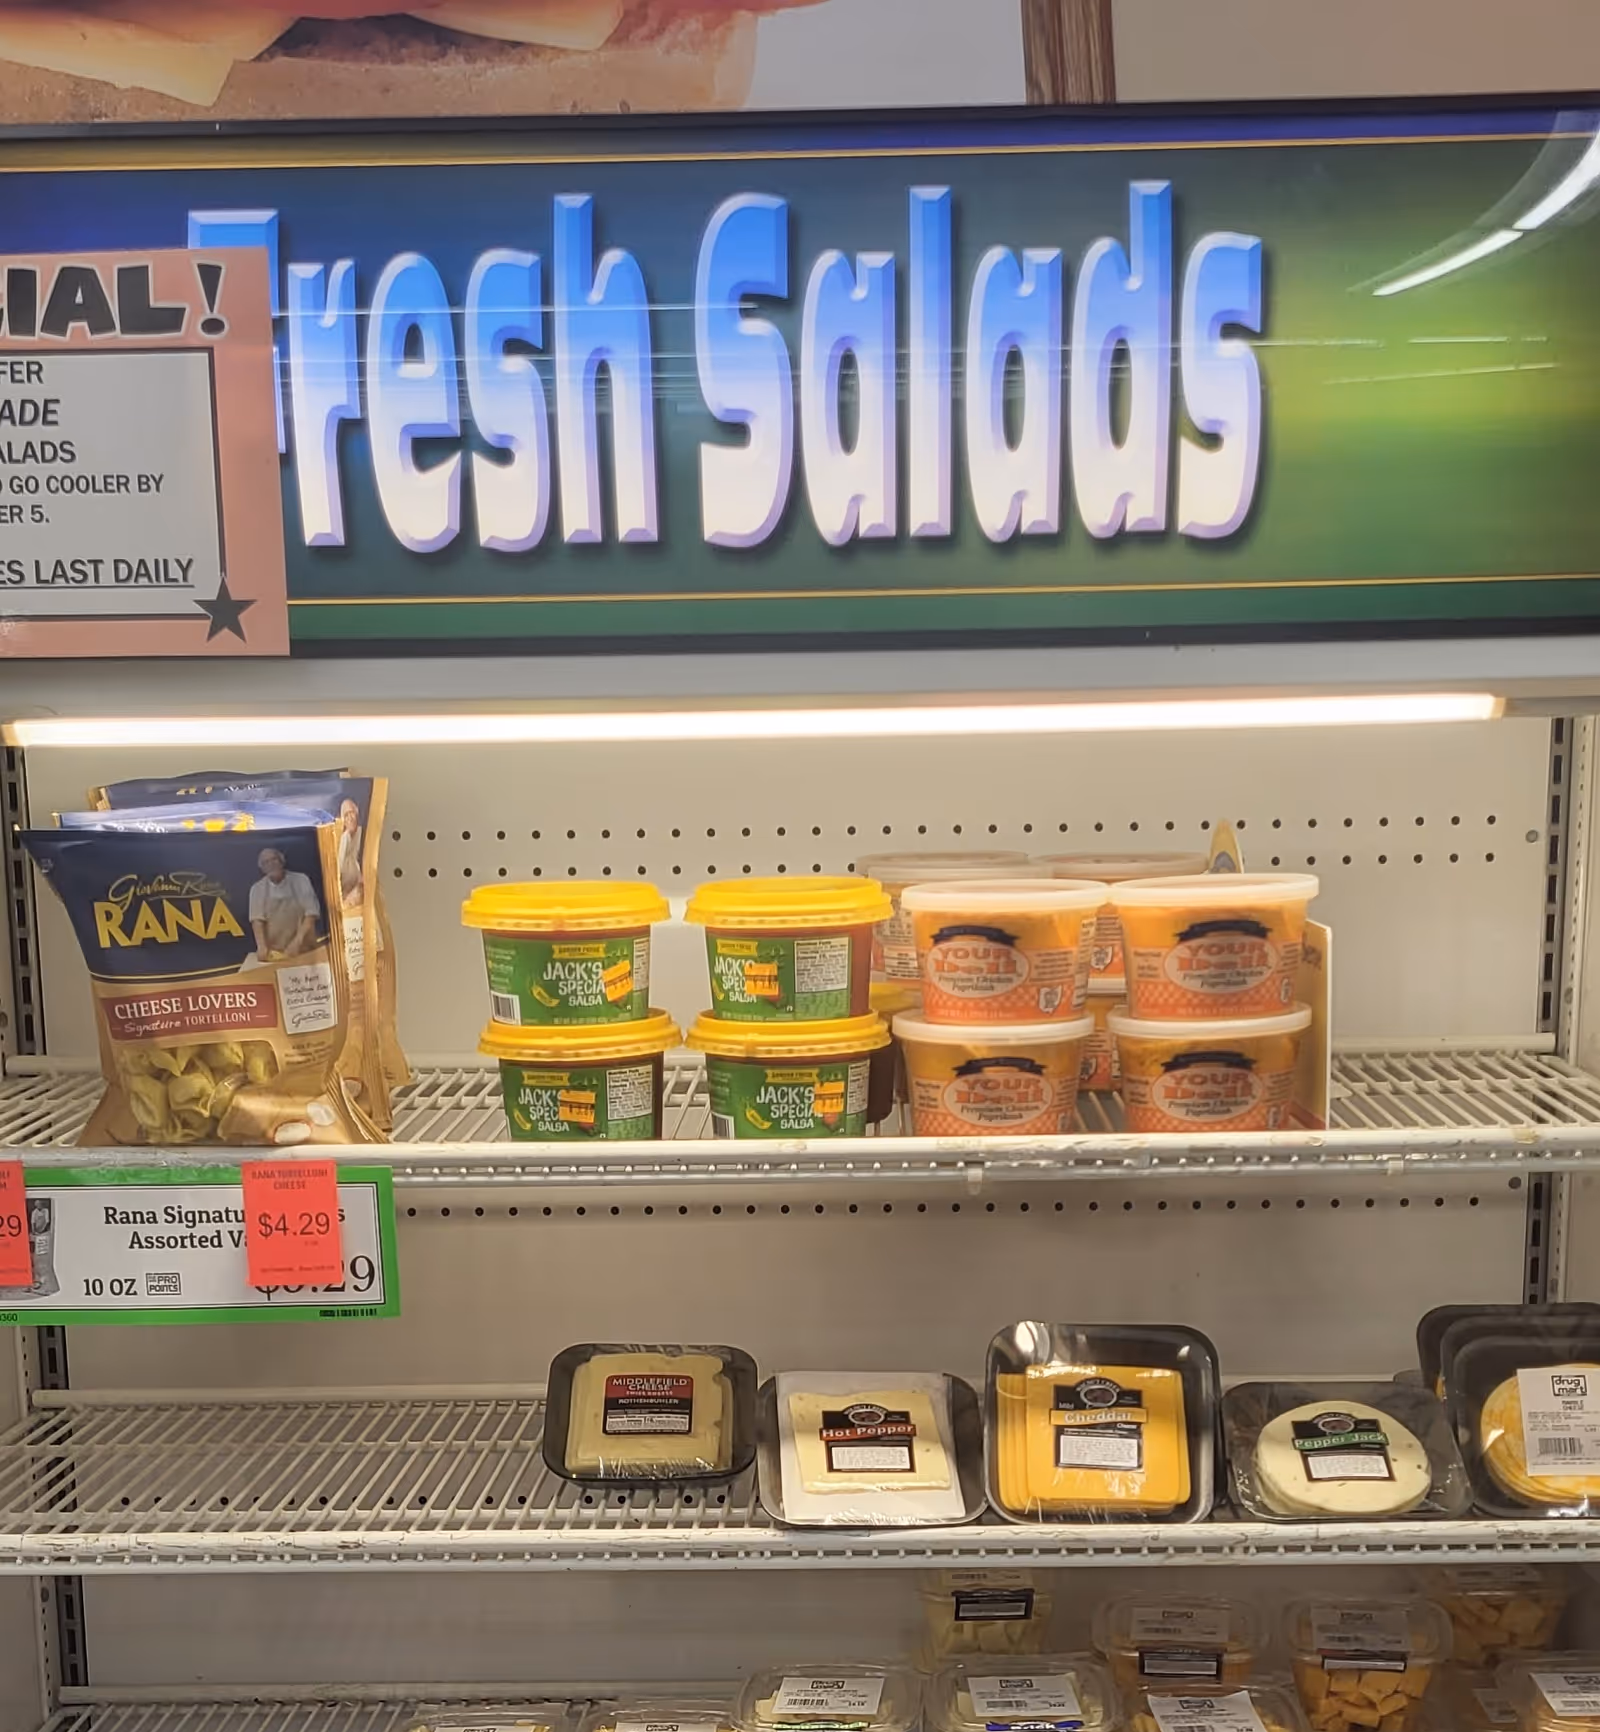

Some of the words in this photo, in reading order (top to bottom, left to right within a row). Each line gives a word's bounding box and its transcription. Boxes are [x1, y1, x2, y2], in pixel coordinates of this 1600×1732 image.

[0, 261, 229, 338] IAL!
[695, 180, 1263, 548] Salads
[9, 475, 39, 494] GO
[46, 474, 130, 494] COOLER
[137, 473, 164, 493] BY
[31, 504, 50, 523] 5.
[34, 558, 104, 585] LAST
[113, 557, 194, 584] DAILY
[94, 897, 245, 948] RANA
[543, 962, 603, 981] JACK'S
[559, 980, 606, 995] SPECIA
[722, 975, 746, 991] SPEC
[115, 997, 182, 1020] CHEESE
[186, 991, 258, 1012] LOVERS
[568, 995, 603, 1007] SALSA
[124, 1013, 181, 1036] Signature
[184, 1011, 251, 1027] TORTELLONI
[756, 1086, 815, 1104] JACK'S
[530, 1106, 559, 1121] SPEC
[538, 1121, 570, 1132] SALSA
[780, 1119, 814, 1129] SALSA
[104, 1207, 158, 1225] Rana
[164, 1204, 246, 1229] Signatu
[258, 1212, 330, 1239] $4.29
[129, 1231, 222, 1250] Assorted
[84, 1279, 104, 1296] 10
[109, 1279, 138, 1296] OZ
[157, 1276, 178, 1284] PRO
[150, 1285, 179, 1293] POINTS
[612, 1378, 688, 1386] MIDDLEFIELD
[1555, 1376, 1580, 1387] drug
[822, 1429, 851, 1438] Hot
[856, 1425, 914, 1435] Pepper
[1294, 1437, 1345, 1448] Pepper
[1352, 1432, 1386, 1442] Jack
